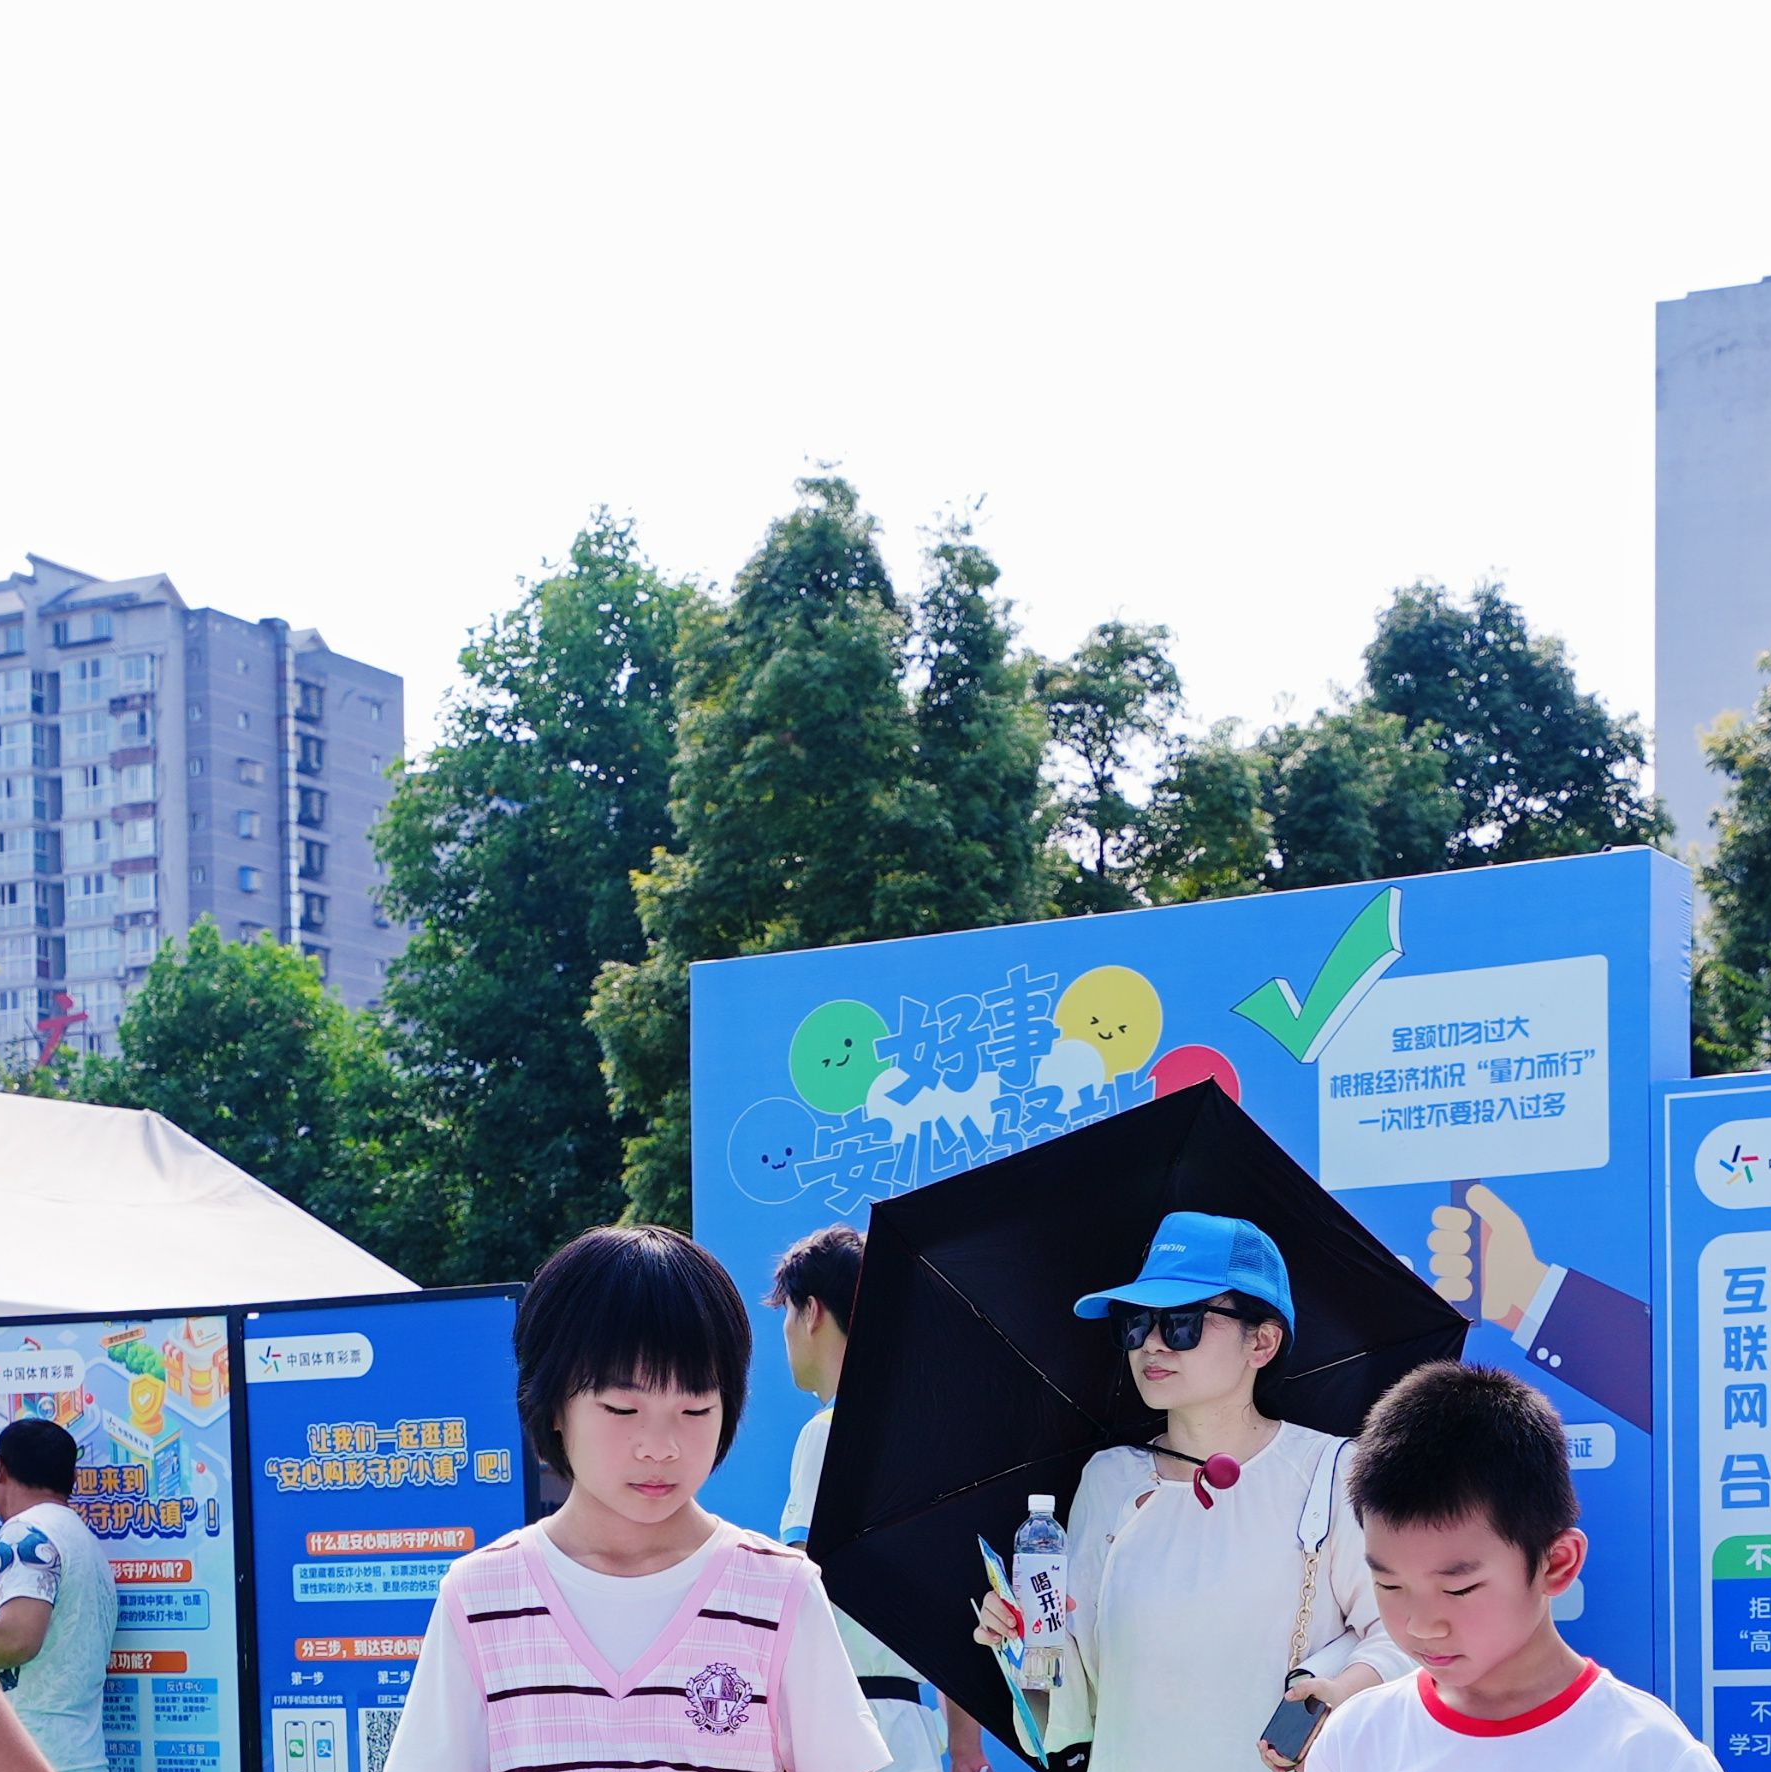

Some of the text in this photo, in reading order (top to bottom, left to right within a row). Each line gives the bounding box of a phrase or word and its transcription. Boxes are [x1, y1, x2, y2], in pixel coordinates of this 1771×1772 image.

[873, 964, 1062, 1106] 好事
[1392, 1016, 1529, 1053] 金额切勿过大
[1330, 1050, 1596, 1099] 根据经济状况“量力而行”
[1358, 1092, 1566, 1132] 一次性不要投入过多
[286, 1350, 362, 1368] 中国体育彩票
[1723, 1266, 1767, 1430] 互联网
[3, 1365, 75, 1381] 中国体育彩票
[309, 1419, 465, 1452] 让我们一起逛逛
[310, 1530, 466, 1552] 什么是安心购彩守护小镇？
[1030, 1571, 1064, 1634] 喝开水
[291, 1671, 324, 1686] 第一步
[378, 1670, 411, 1685] 第二步
